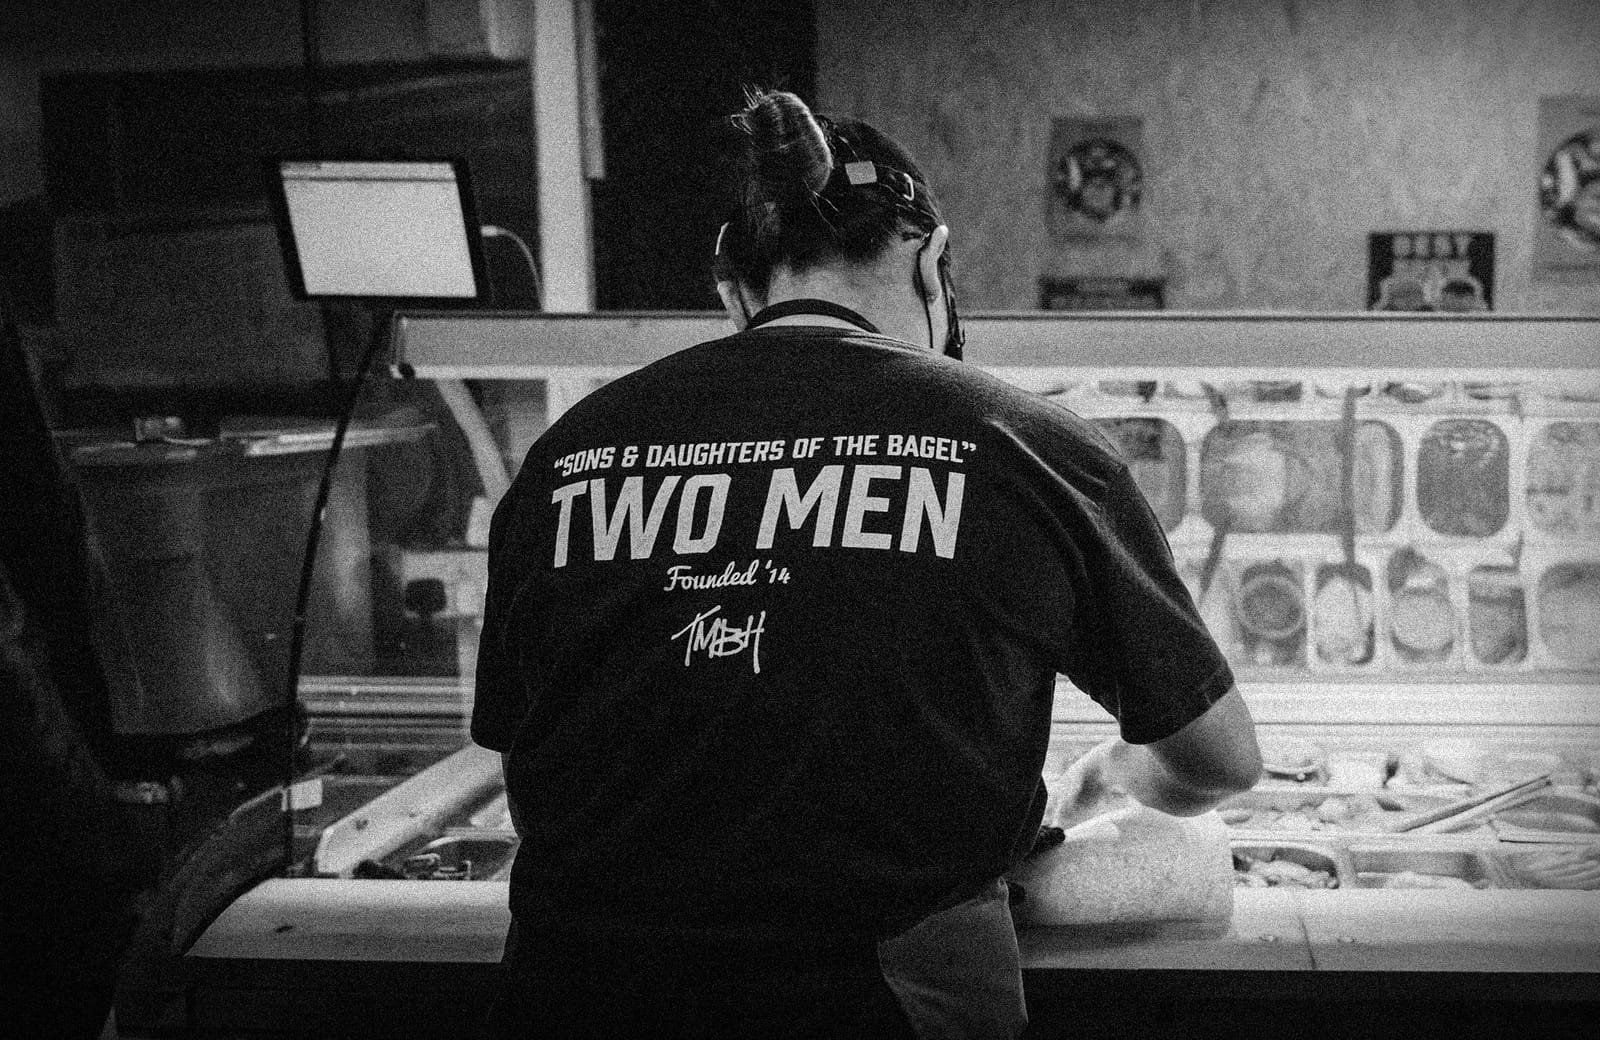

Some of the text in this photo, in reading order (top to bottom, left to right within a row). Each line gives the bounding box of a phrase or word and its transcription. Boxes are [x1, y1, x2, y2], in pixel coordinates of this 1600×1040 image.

[621, 446, 639, 468] &
[645, 440, 786, 467] DAUGHTERS
[792, 437, 825, 459] OF
[832, 434, 880, 456] THE
[551, 464, 966, 569] TWO MEN
[663, 559, 760, 592] Founded
